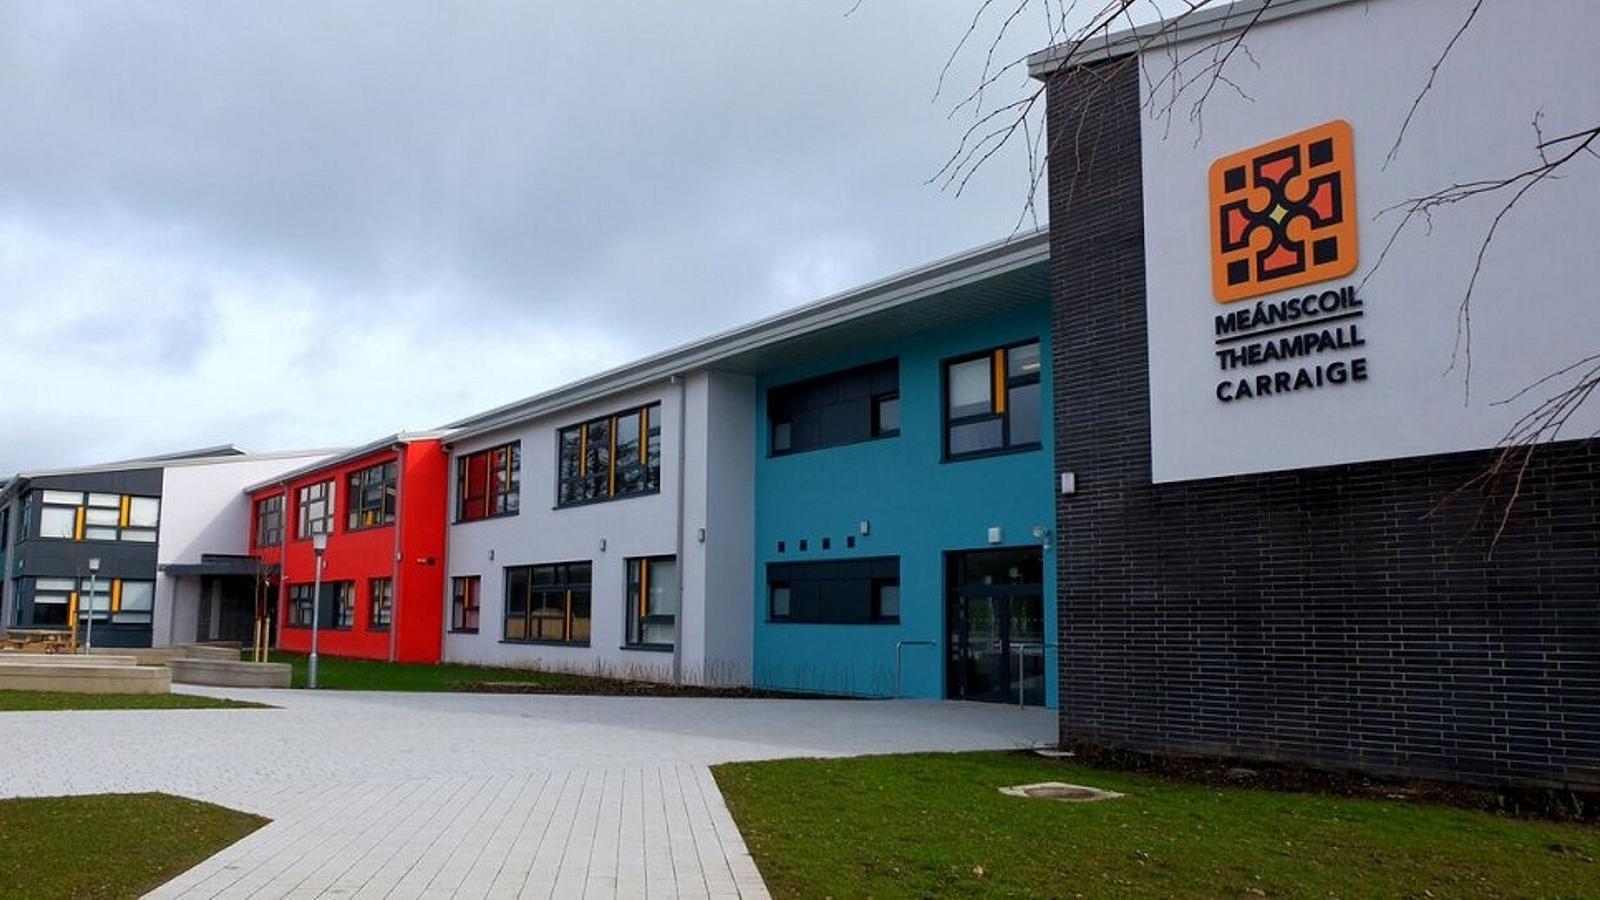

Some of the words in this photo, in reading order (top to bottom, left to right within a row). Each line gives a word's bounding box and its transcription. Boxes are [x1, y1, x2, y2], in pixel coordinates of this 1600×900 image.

[1215, 286, 1363, 335] MEÁNSCOIL
[1216, 325, 1365, 370] THEAMPALL
[1216, 358, 1368, 402] CARRAIGE
